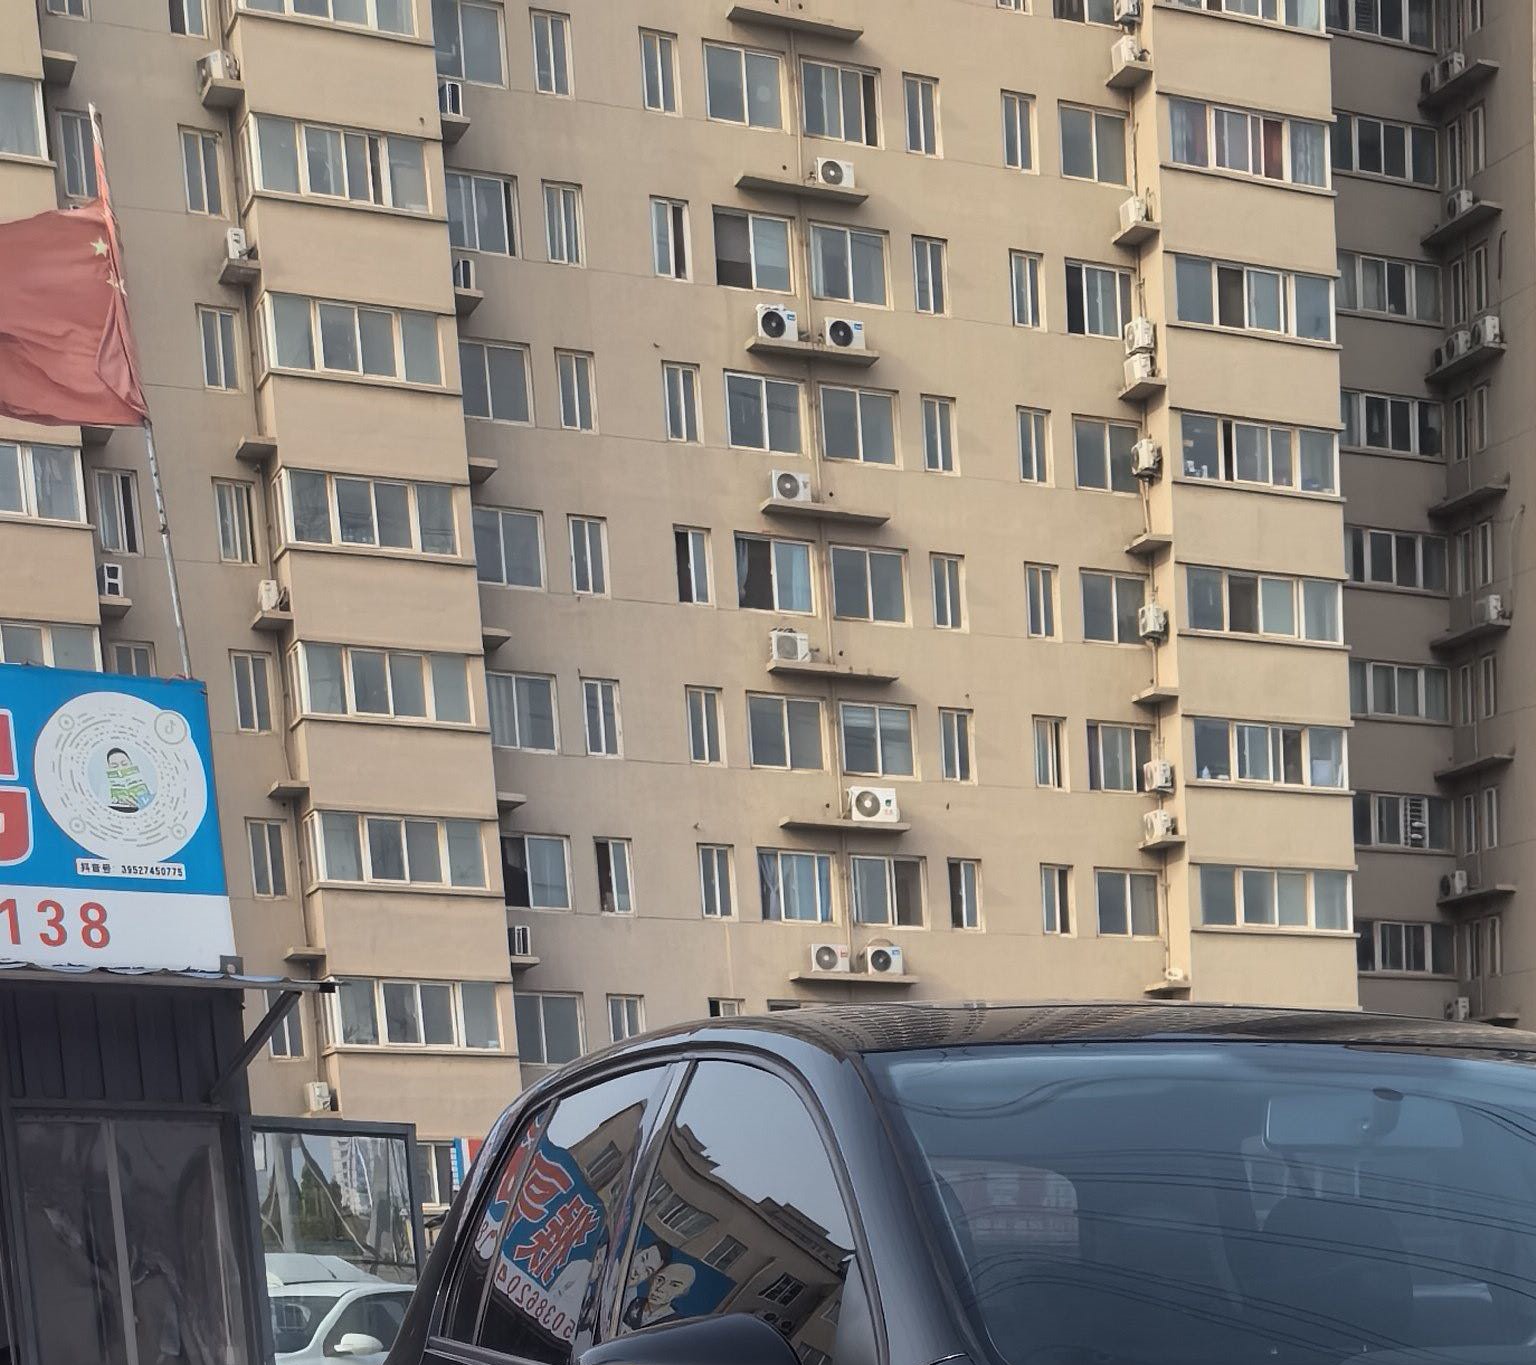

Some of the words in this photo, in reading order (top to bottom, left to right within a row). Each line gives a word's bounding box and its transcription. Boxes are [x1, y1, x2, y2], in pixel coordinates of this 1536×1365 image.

[81, 862, 111, 874] 抖音号
[121, 865, 183, 877] 39527450775
